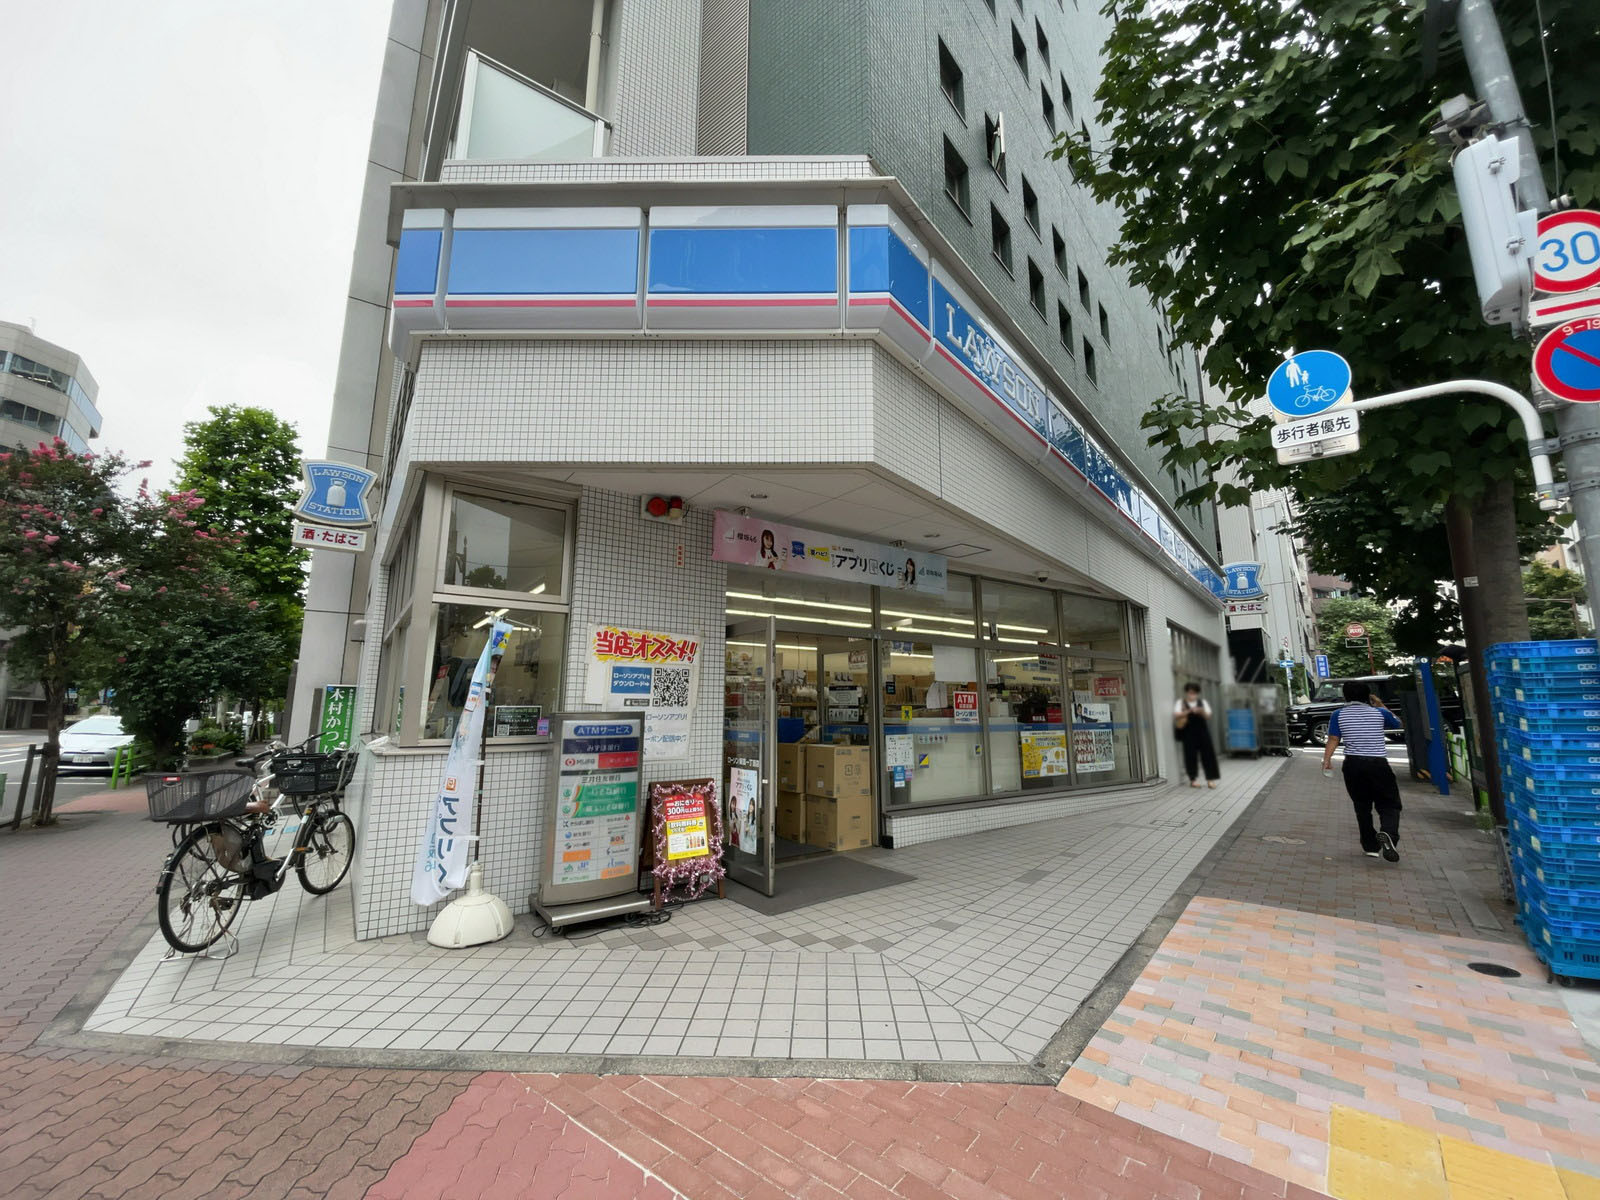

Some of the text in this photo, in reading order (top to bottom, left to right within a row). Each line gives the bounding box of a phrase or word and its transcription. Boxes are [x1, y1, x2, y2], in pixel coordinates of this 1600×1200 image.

[1540, 230, 1600, 272] 30
[946, 302, 1043, 425] LAWSON
[1277, 416, 1351, 443] 歩行者優先
[313, 468, 365, 483] LAWSON
[308, 502, 361, 516] STATION
[302, 528, 359, 546] 酒・たばこ
[835, 554, 868, 573] アプリ
[879, 561, 895, 577] くじ
[957, 695, 975, 704] ATM
[577, 726, 630, 735] ATMサービス
